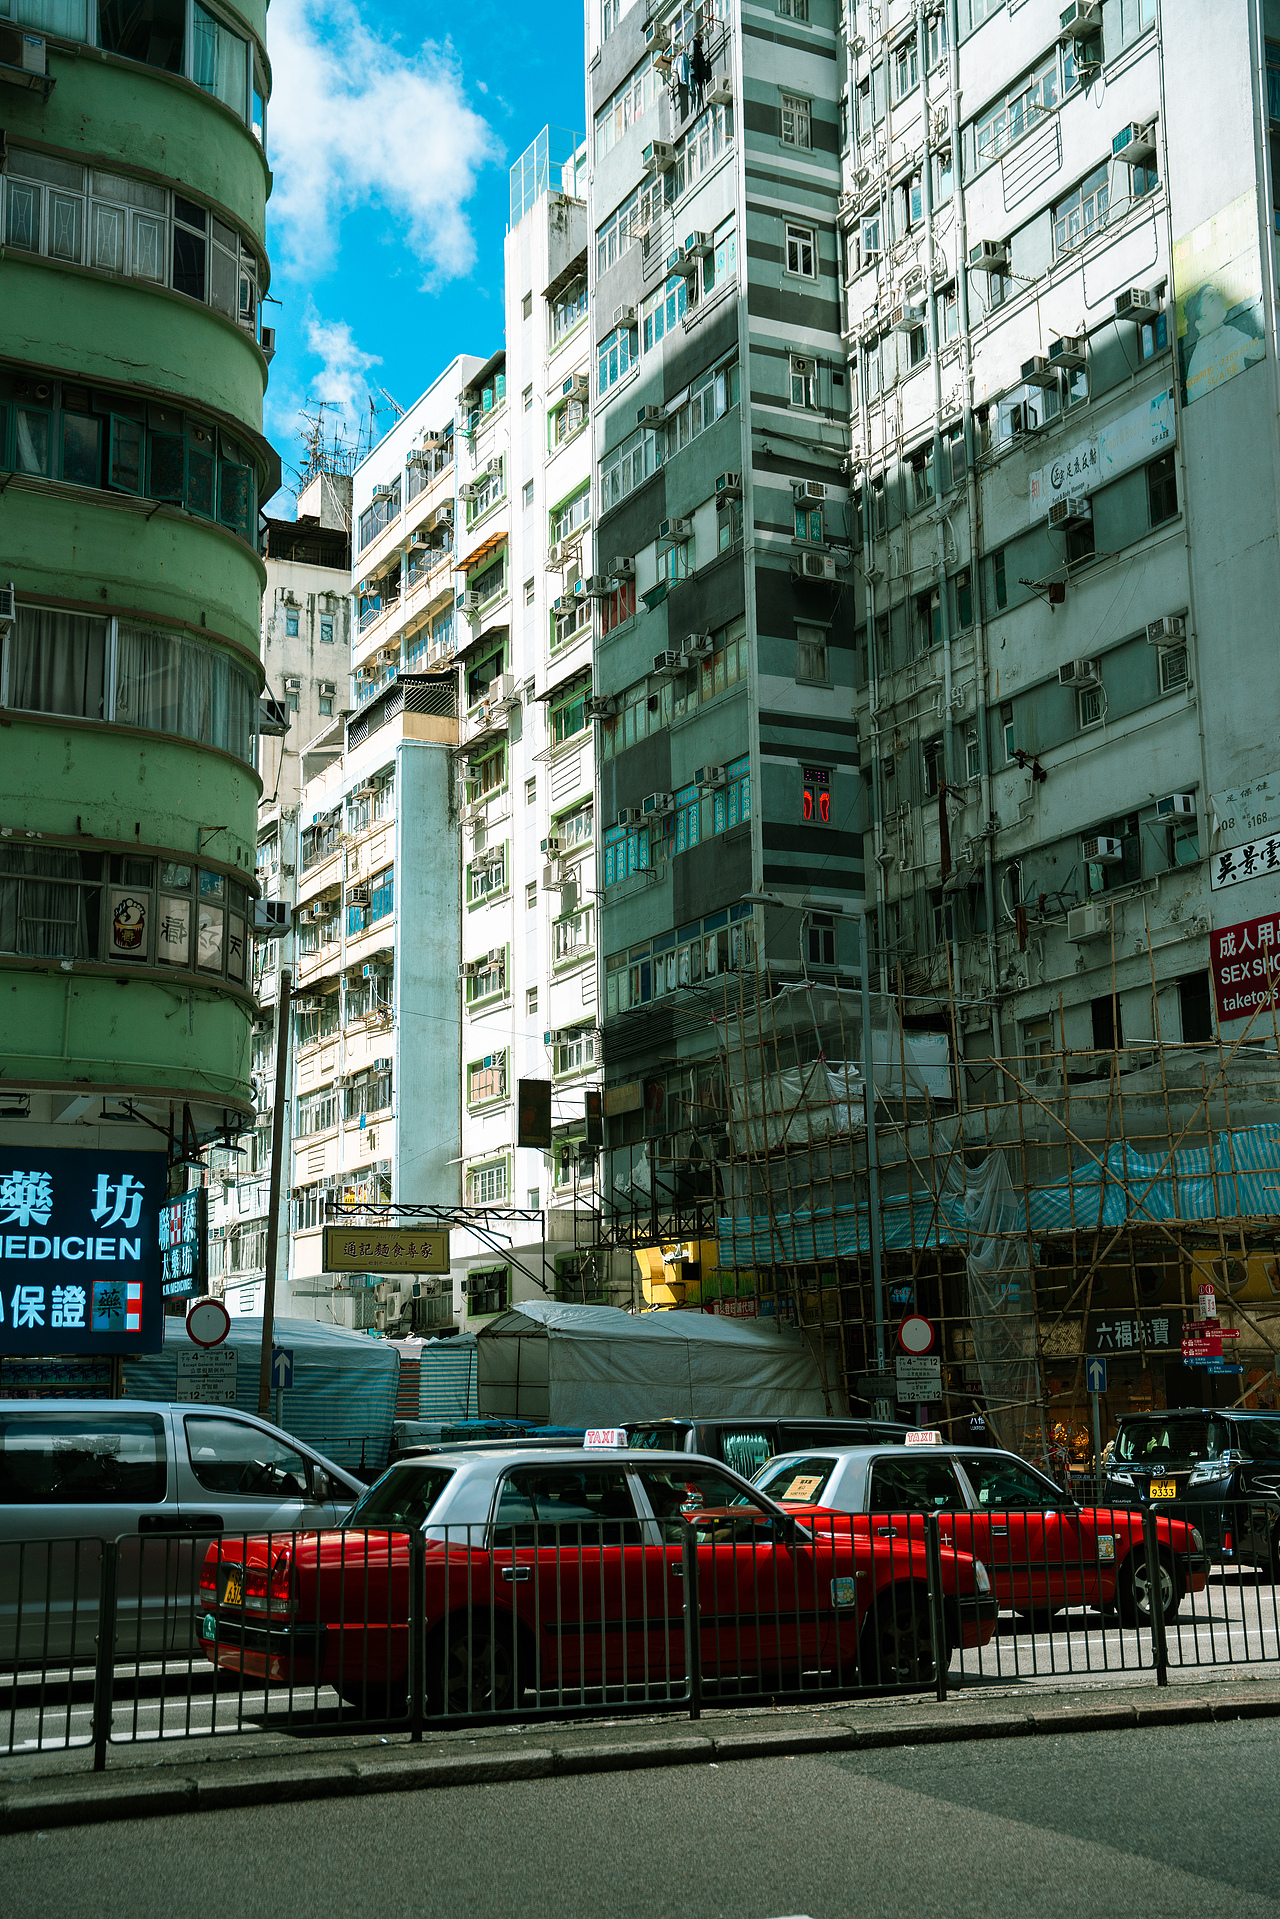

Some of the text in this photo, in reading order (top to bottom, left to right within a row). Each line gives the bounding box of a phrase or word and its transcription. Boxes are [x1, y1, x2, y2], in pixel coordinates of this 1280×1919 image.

[1219, 919, 1280, 959] 成人用
[1221, 961, 1251, 985] SEX
[0, 1235, 141, 1261] EDICIEN
[343, 1241, 434, 1259] 通記麵食專家
[0, 1284, 86, 1329] 保證
[1096, 1317, 1170, 1349] 六福珠寶
[224, 1351, 235, 1360] 12
[930, 1358, 938, 1366] 12
[225, 1390, 235, 1399] 12
[933, 1391, 941, 1399] 12
[587, 1430, 615, 1444] TAXI
[907, 1431, 933, 1442] TAXI
[1157, 1480, 1169, 1488] JV
[1151, 1488, 1174, 1497] 9333
